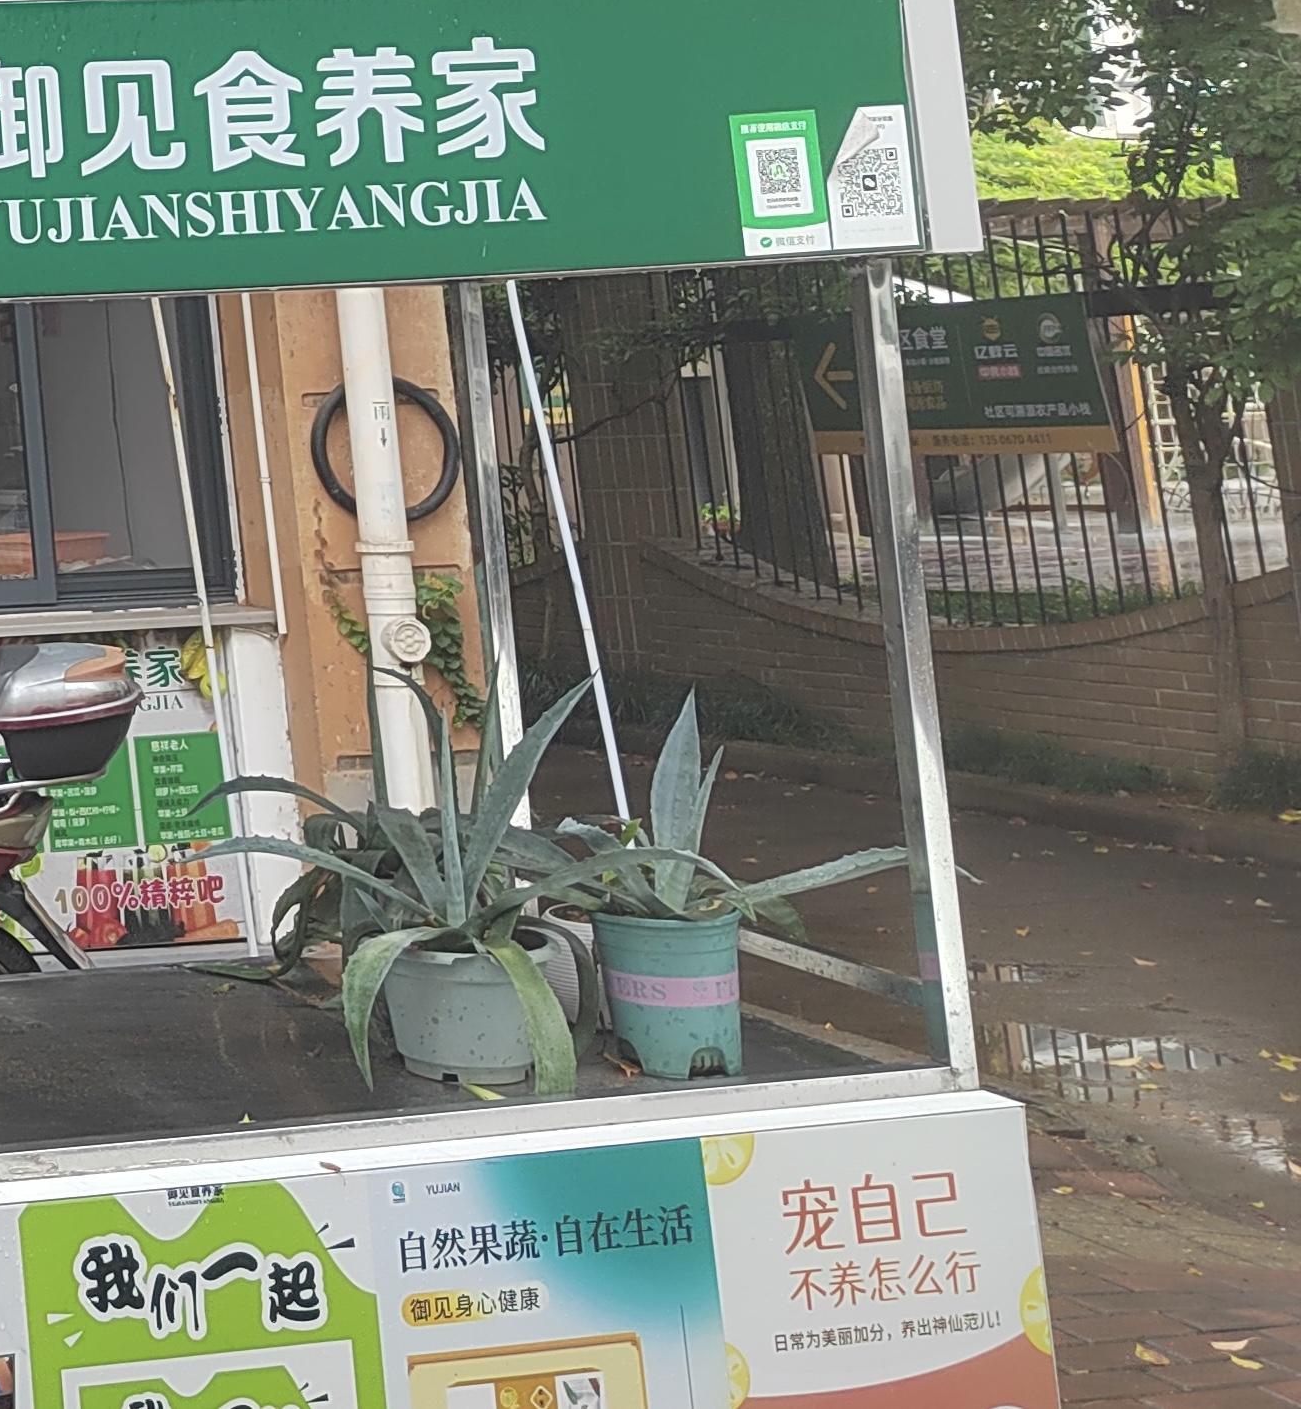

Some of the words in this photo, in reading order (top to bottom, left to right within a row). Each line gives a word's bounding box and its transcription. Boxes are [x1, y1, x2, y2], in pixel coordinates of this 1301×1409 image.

[775, 234, 816, 247] 微信支付
[425, 1181, 461, 1195] YUJIAN
[781, 1171, 968, 1255] 宠自己
[398, 1202, 694, 1274] 自然果蔬·自在生活
[81, 1242, 321, 1331] 我们一起
[409, 1286, 541, 1323] 御见身心健康
[789, 1251, 982, 1312] 不养怎么行
